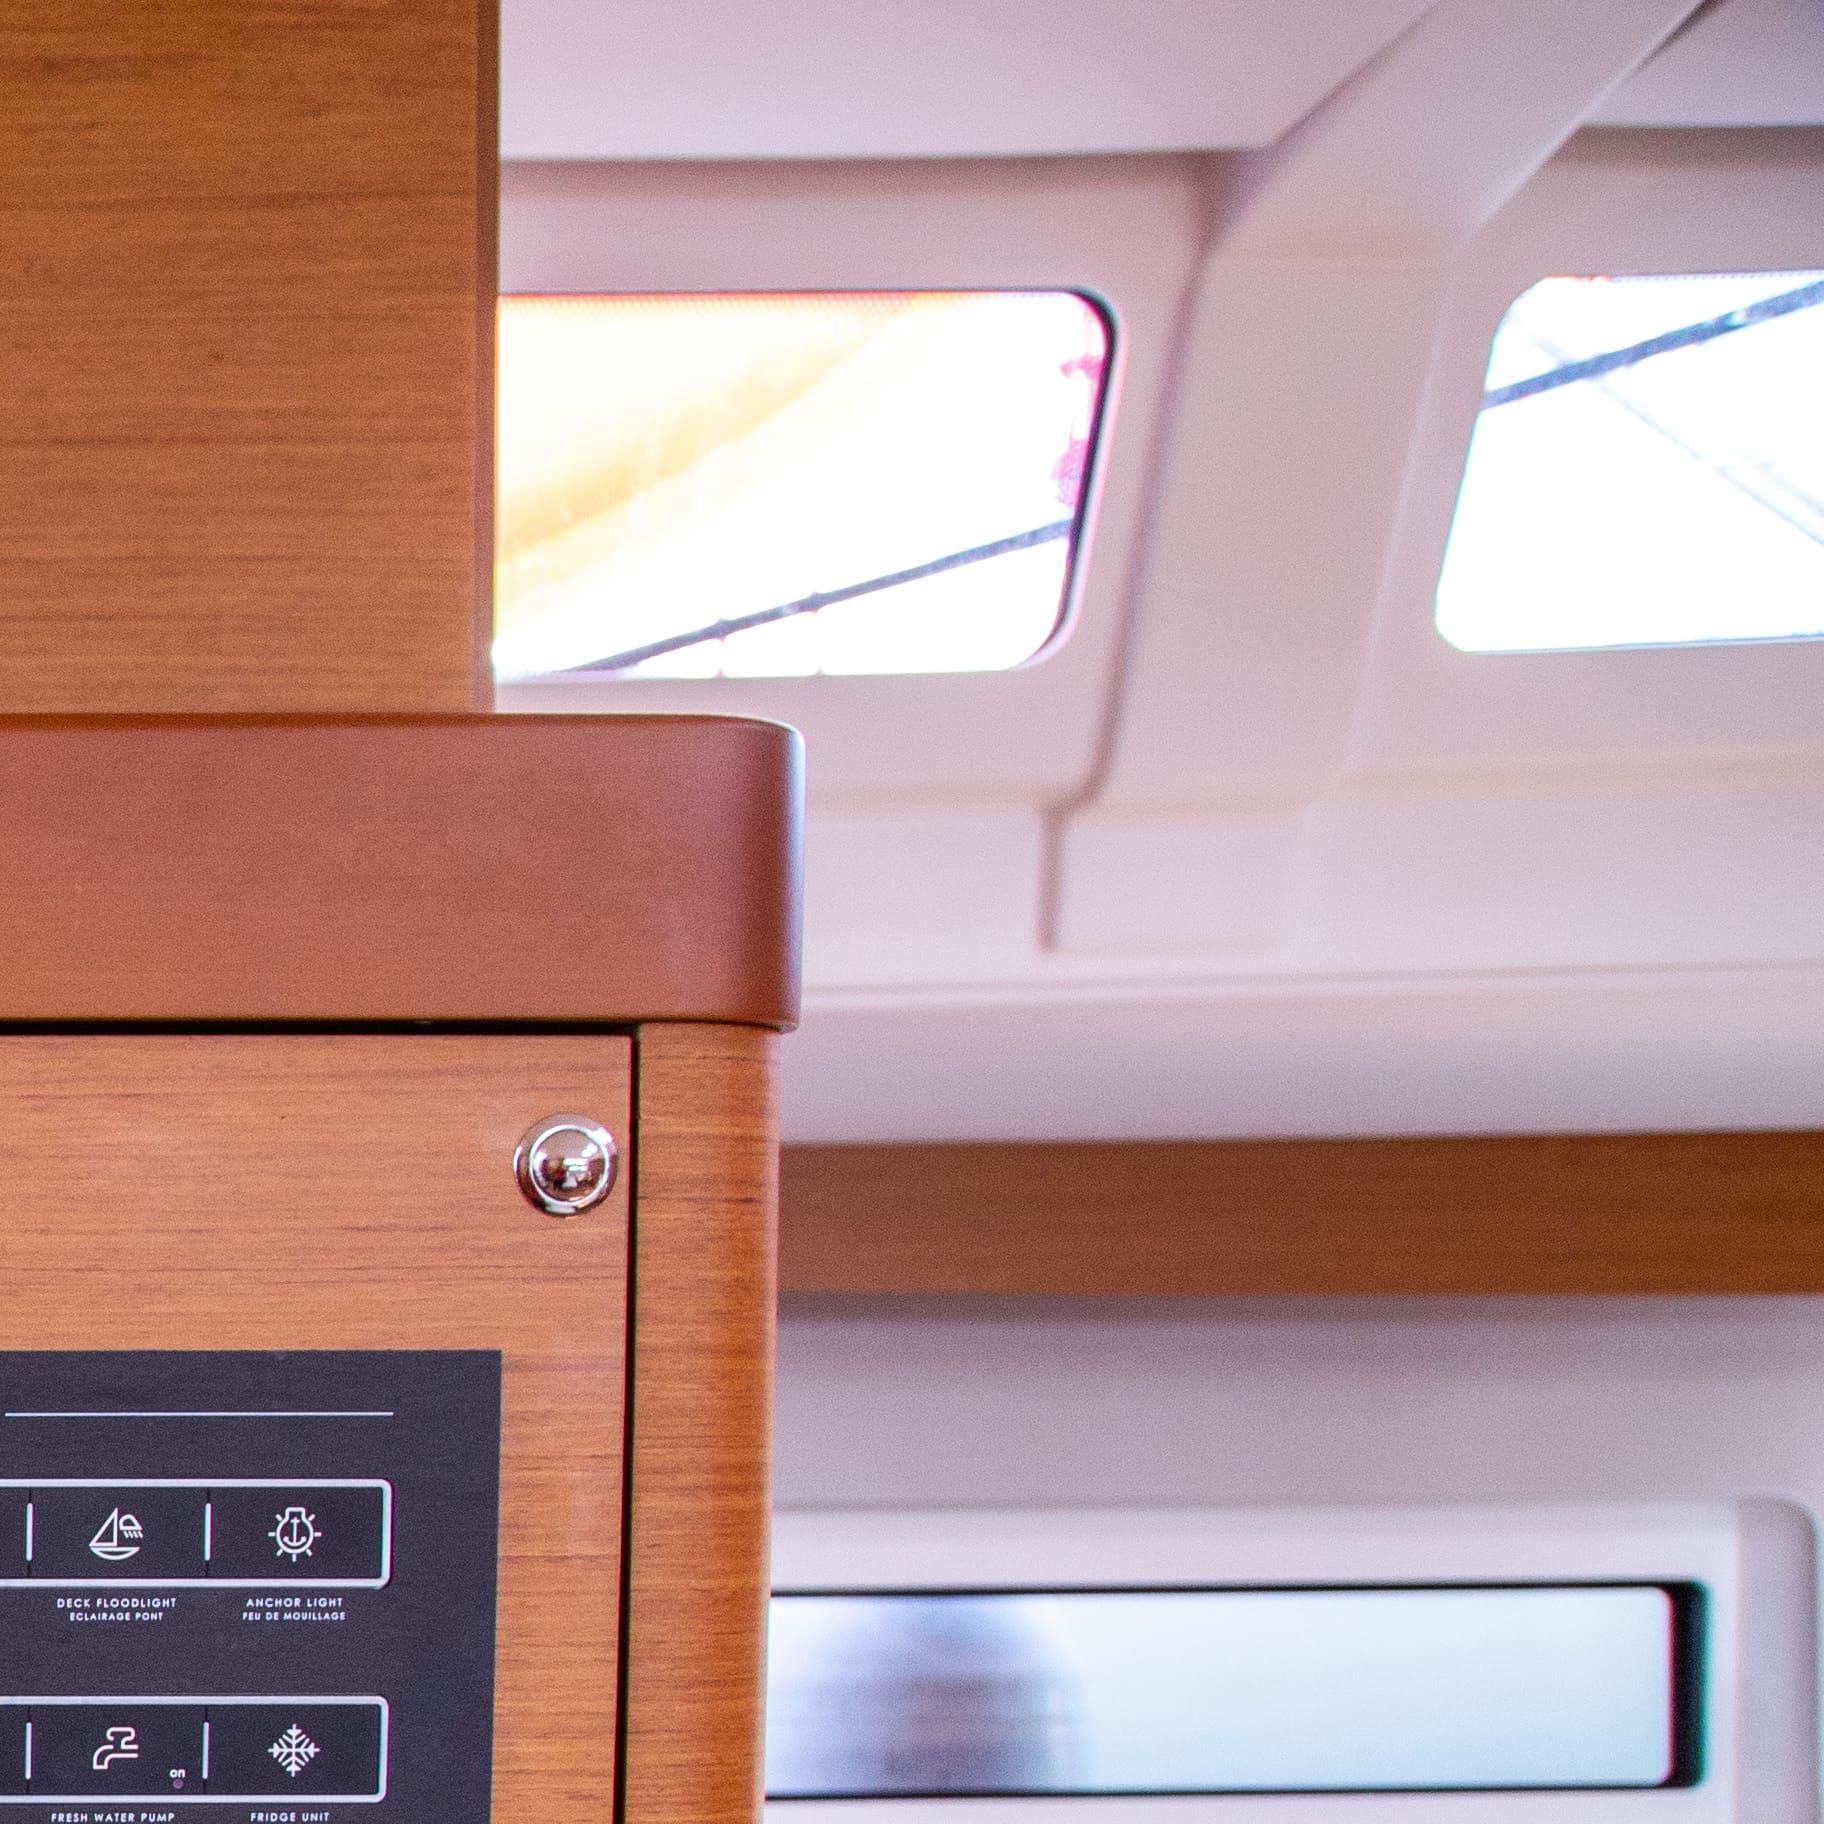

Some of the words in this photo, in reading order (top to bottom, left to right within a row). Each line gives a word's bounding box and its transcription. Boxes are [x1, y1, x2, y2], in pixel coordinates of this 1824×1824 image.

[57, 1598, 90, 1608] DECK
[97, 1598, 175, 1608] FLOODLIGHT
[246, 1598, 300, 1607] ANCHOR
[307, 1598, 342, 1607] LIGHT
[70, 1612, 130, 1621] ECLAIRAGE
[135, 1612, 163, 1620] PONT
[243, 1612, 261, 1620] FEU
[266, 1612, 279, 1620] DE
[284, 1612, 345, 1620] MOUILLAGE
[170, 1769, 185, 1778] on
[51, 1813, 87, 1822] FRESH
[95, 1813, 134, 1822] WATER
[141, 1813, 174, 1822] PUMP
[251, 1812, 295, 1822] FRIDGE
[302, 1812, 329, 1822] UNIT
